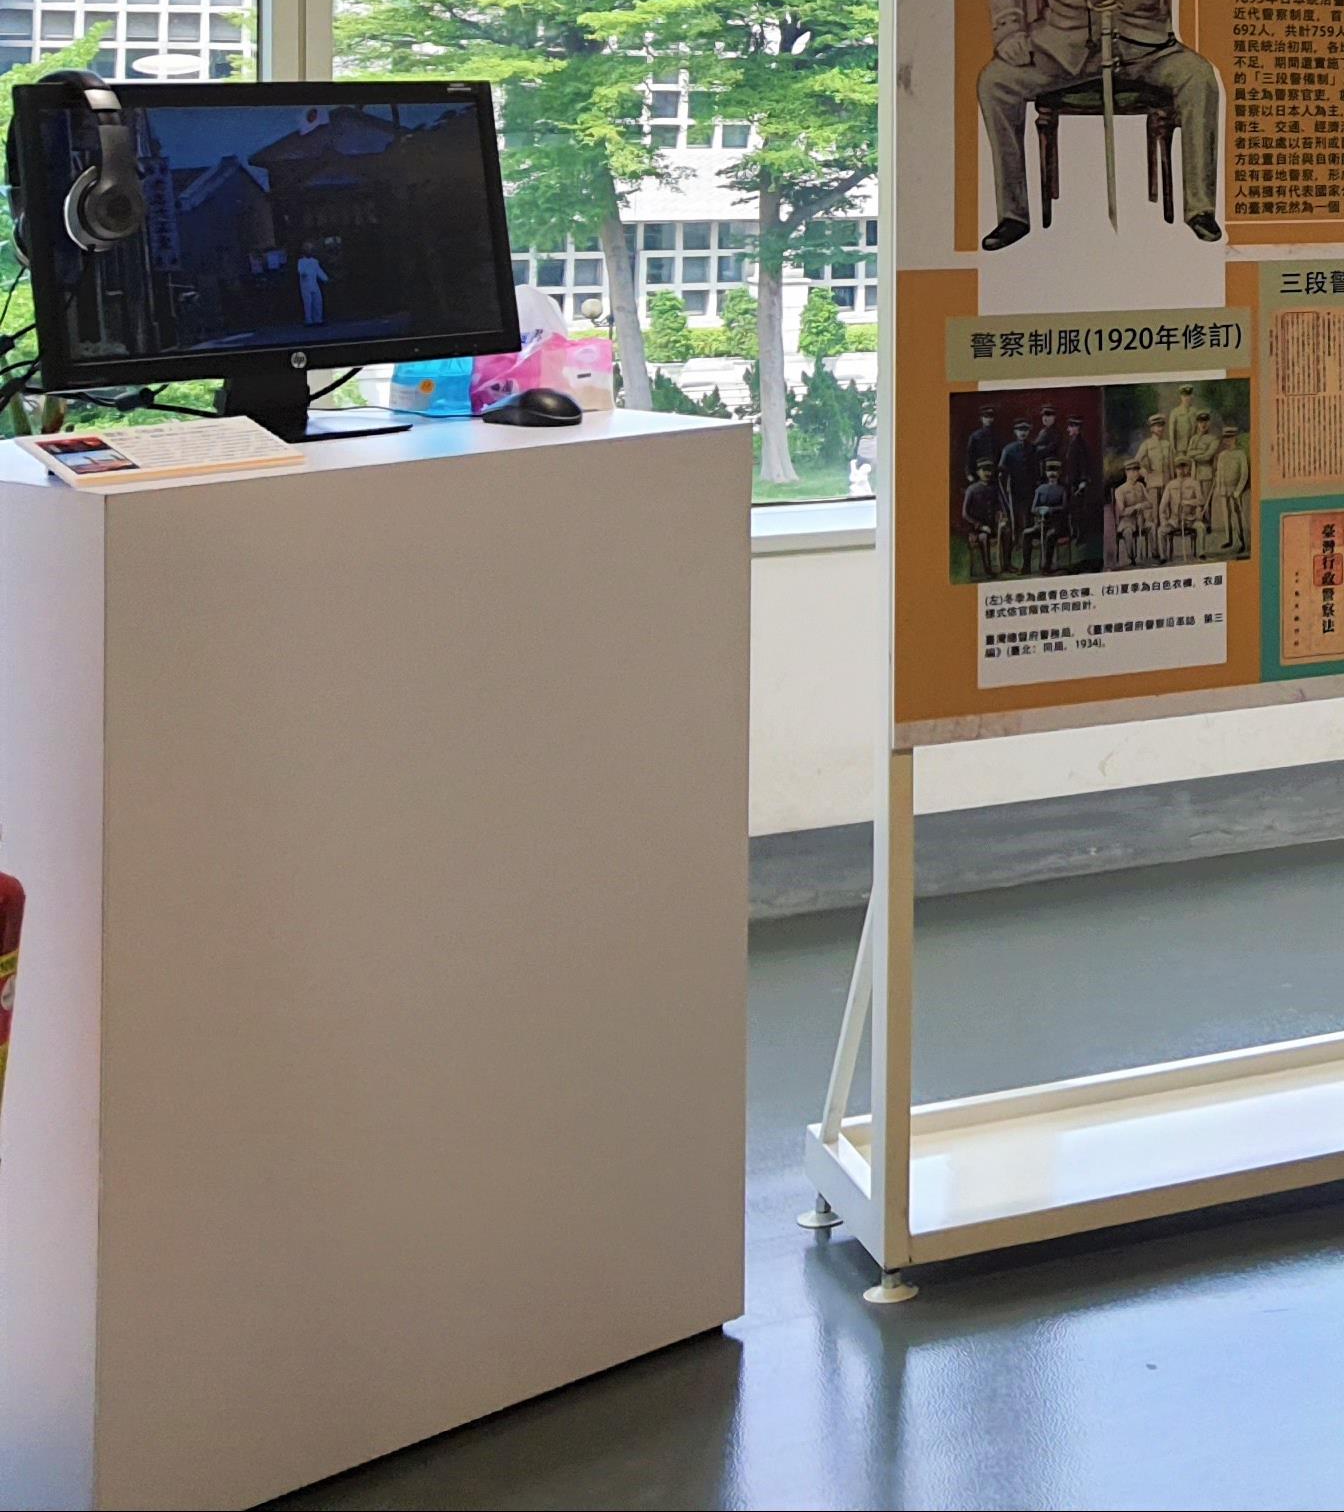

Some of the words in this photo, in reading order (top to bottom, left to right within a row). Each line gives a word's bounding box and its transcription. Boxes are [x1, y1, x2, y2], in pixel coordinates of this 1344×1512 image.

[970, 323, 1242, 360] 警察制服(1920年修訂)
